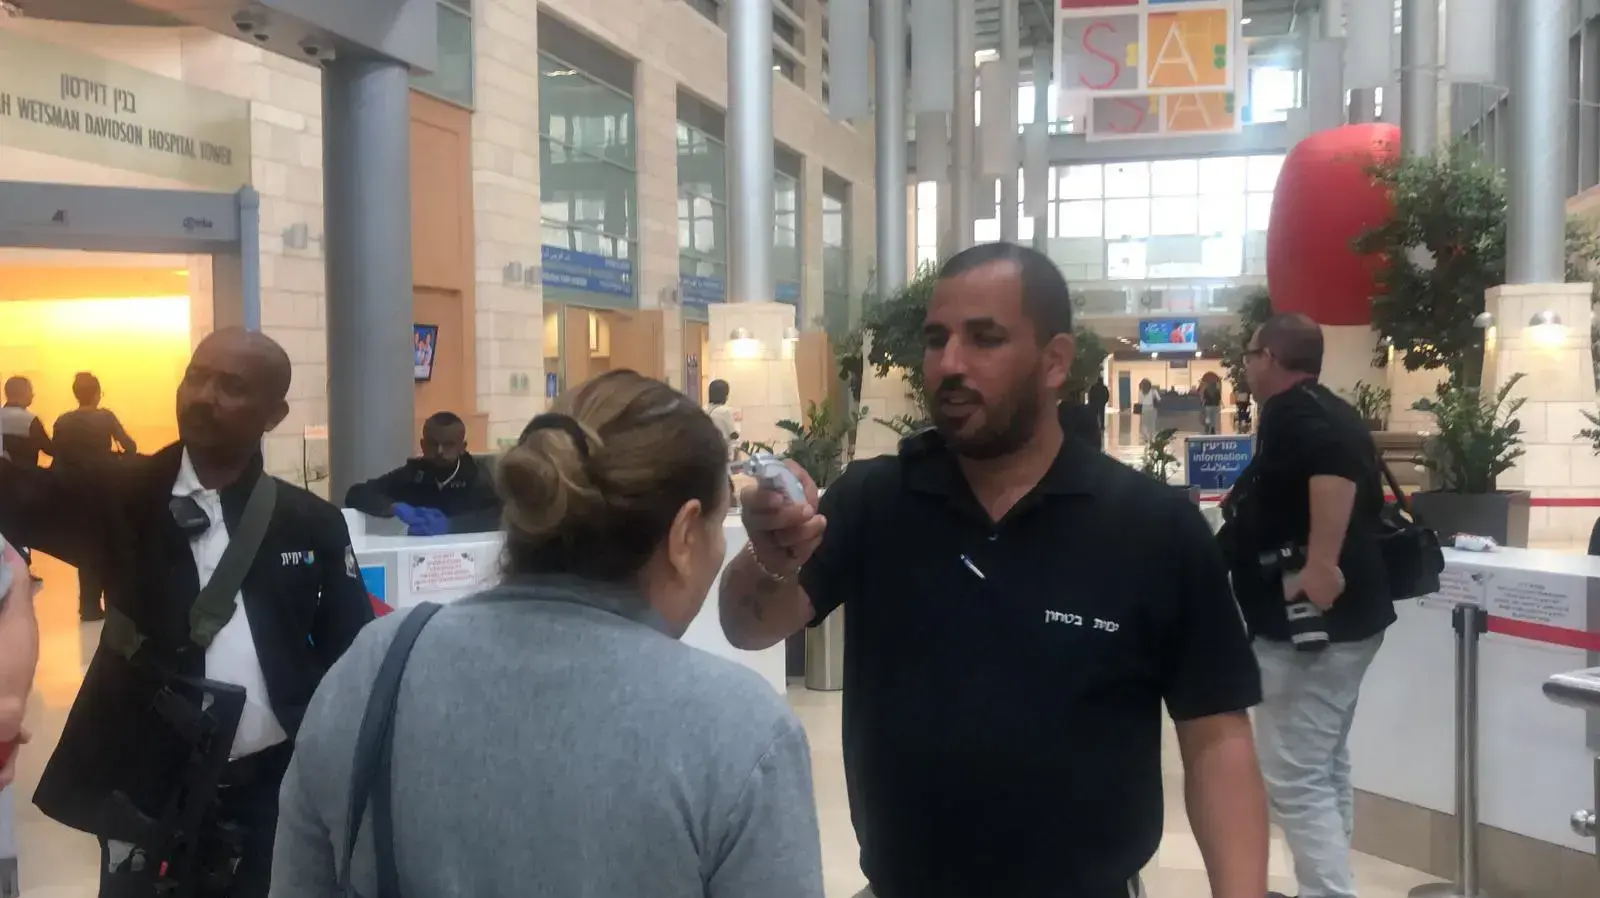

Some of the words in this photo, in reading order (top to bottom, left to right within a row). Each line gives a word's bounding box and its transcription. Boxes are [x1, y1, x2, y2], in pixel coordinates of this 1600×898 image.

[60, 72, 107, 107] דוידסון
[113, 87, 136, 114] בנין
[0, 91, 11, 116] H
[17, 96, 80, 132] WETSMAN
[85, 112, 143, 147] DAVIDSON
[148, 128, 197, 160] HOSPITAL
[200, 140, 232, 166] TOWER
[1193, 453, 1248, 462] information
[281, 551, 302, 566] ימית
[1045, 609, 1083, 626] בטחון
